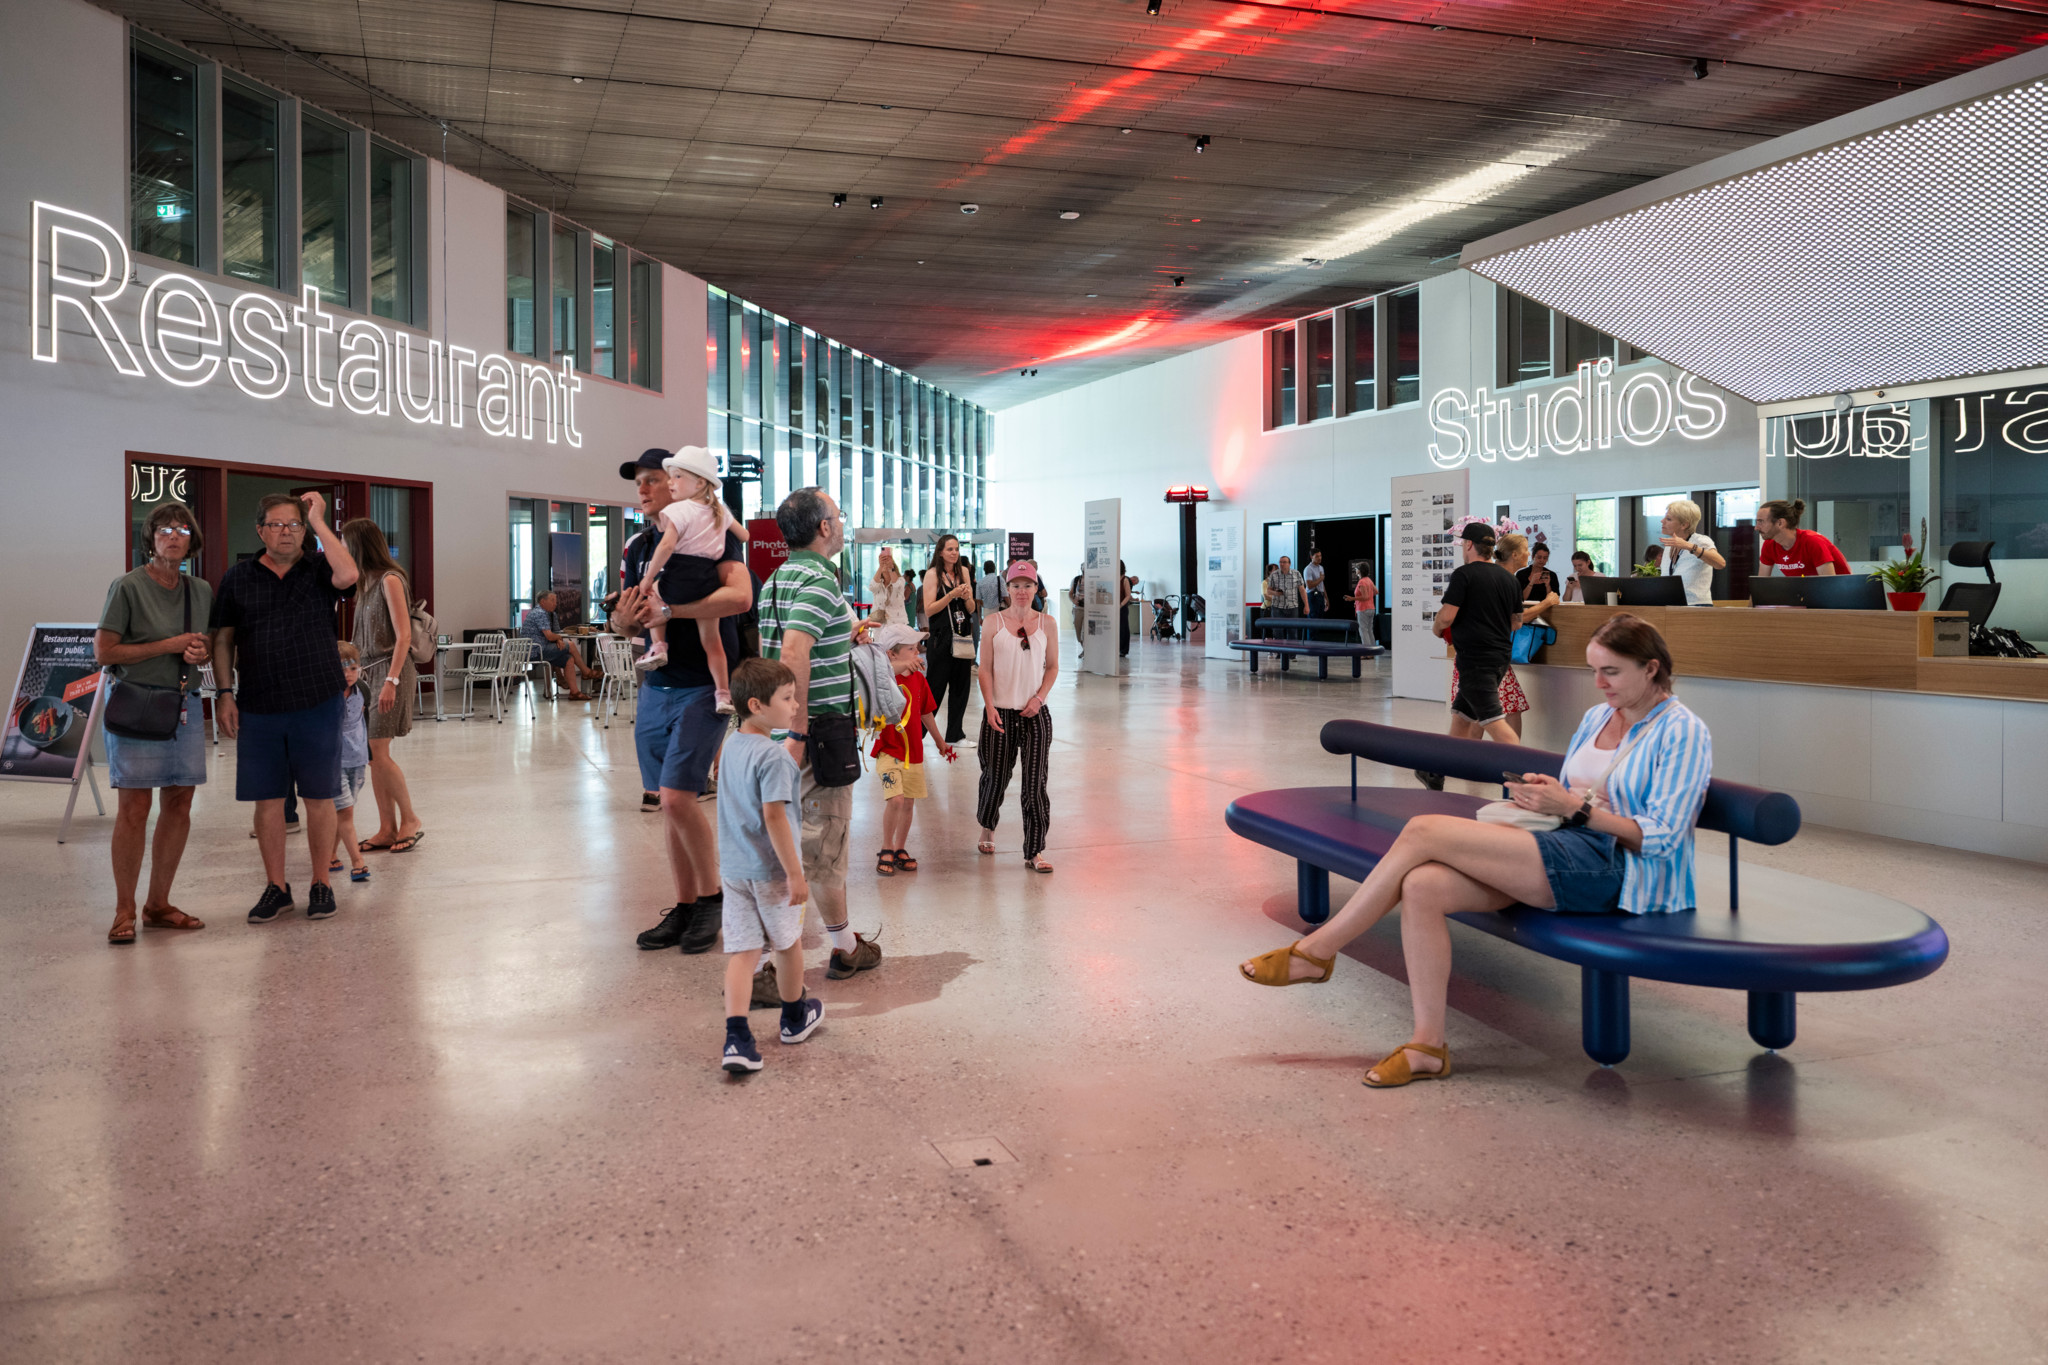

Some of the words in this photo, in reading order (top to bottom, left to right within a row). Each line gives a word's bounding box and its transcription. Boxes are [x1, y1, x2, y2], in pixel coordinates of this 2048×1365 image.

[31, 200, 583, 448] Restaurant
[1427, 356, 1727, 469] Studios
[1401, 523, 1413, 531] 2025
[753, 540, 788, 549] Photo
[771, 549, 791, 557] Lab
[43, 635, 79, 643] Restaurant
[64, 645, 85, 655] public
